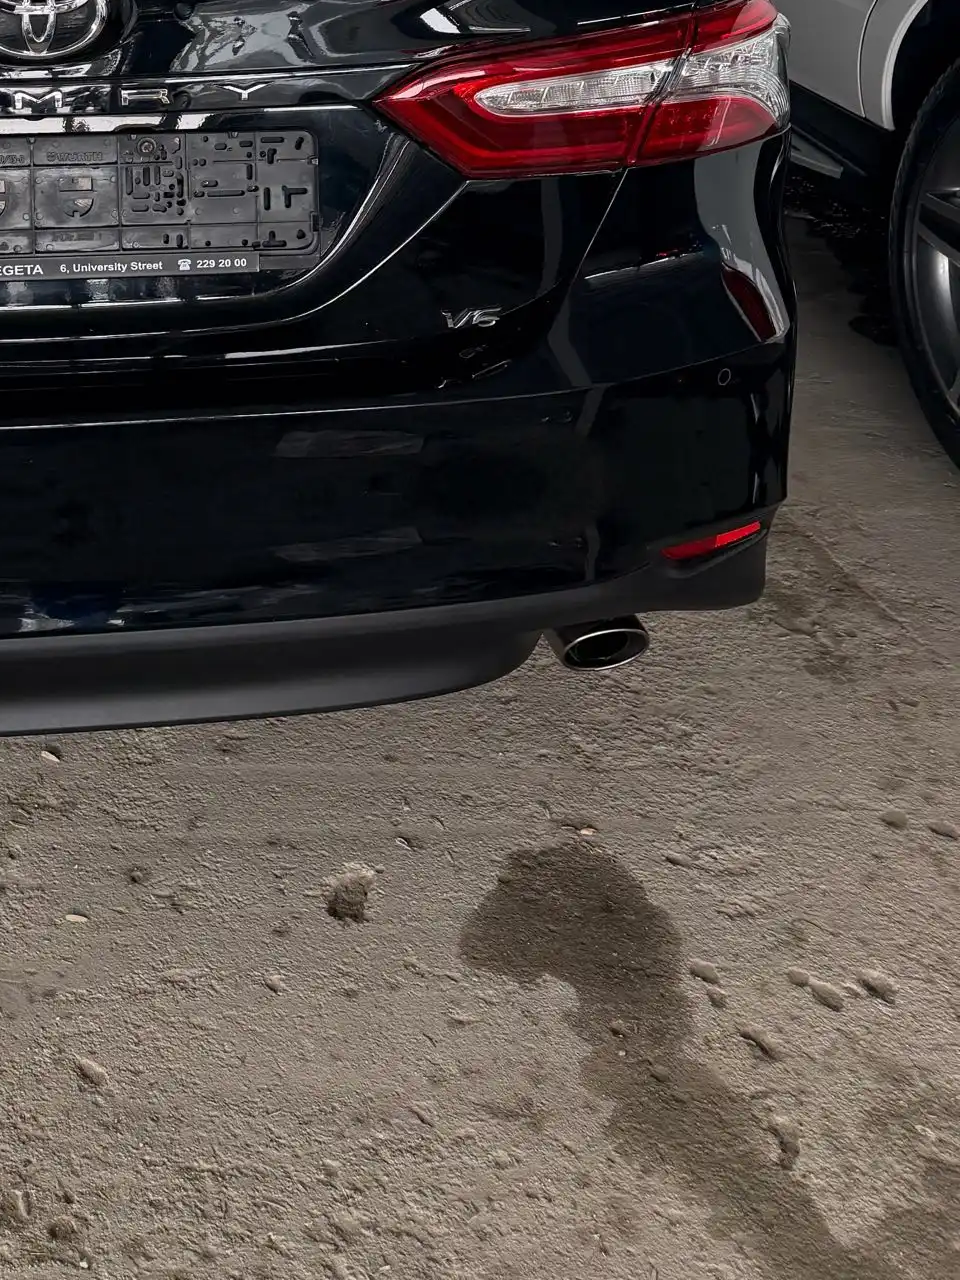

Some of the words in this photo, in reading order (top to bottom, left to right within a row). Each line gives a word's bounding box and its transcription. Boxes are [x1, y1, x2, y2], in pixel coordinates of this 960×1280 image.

[59, 263, 70, 274] 6,
[72, 261, 128, 274] University
[130, 261, 163, 271] Street
[196, 259, 216, 269] 229
[218, 258, 231, 268] 20
[234, 258, 247, 268] 00
[440, 305, 502, 329] V6
